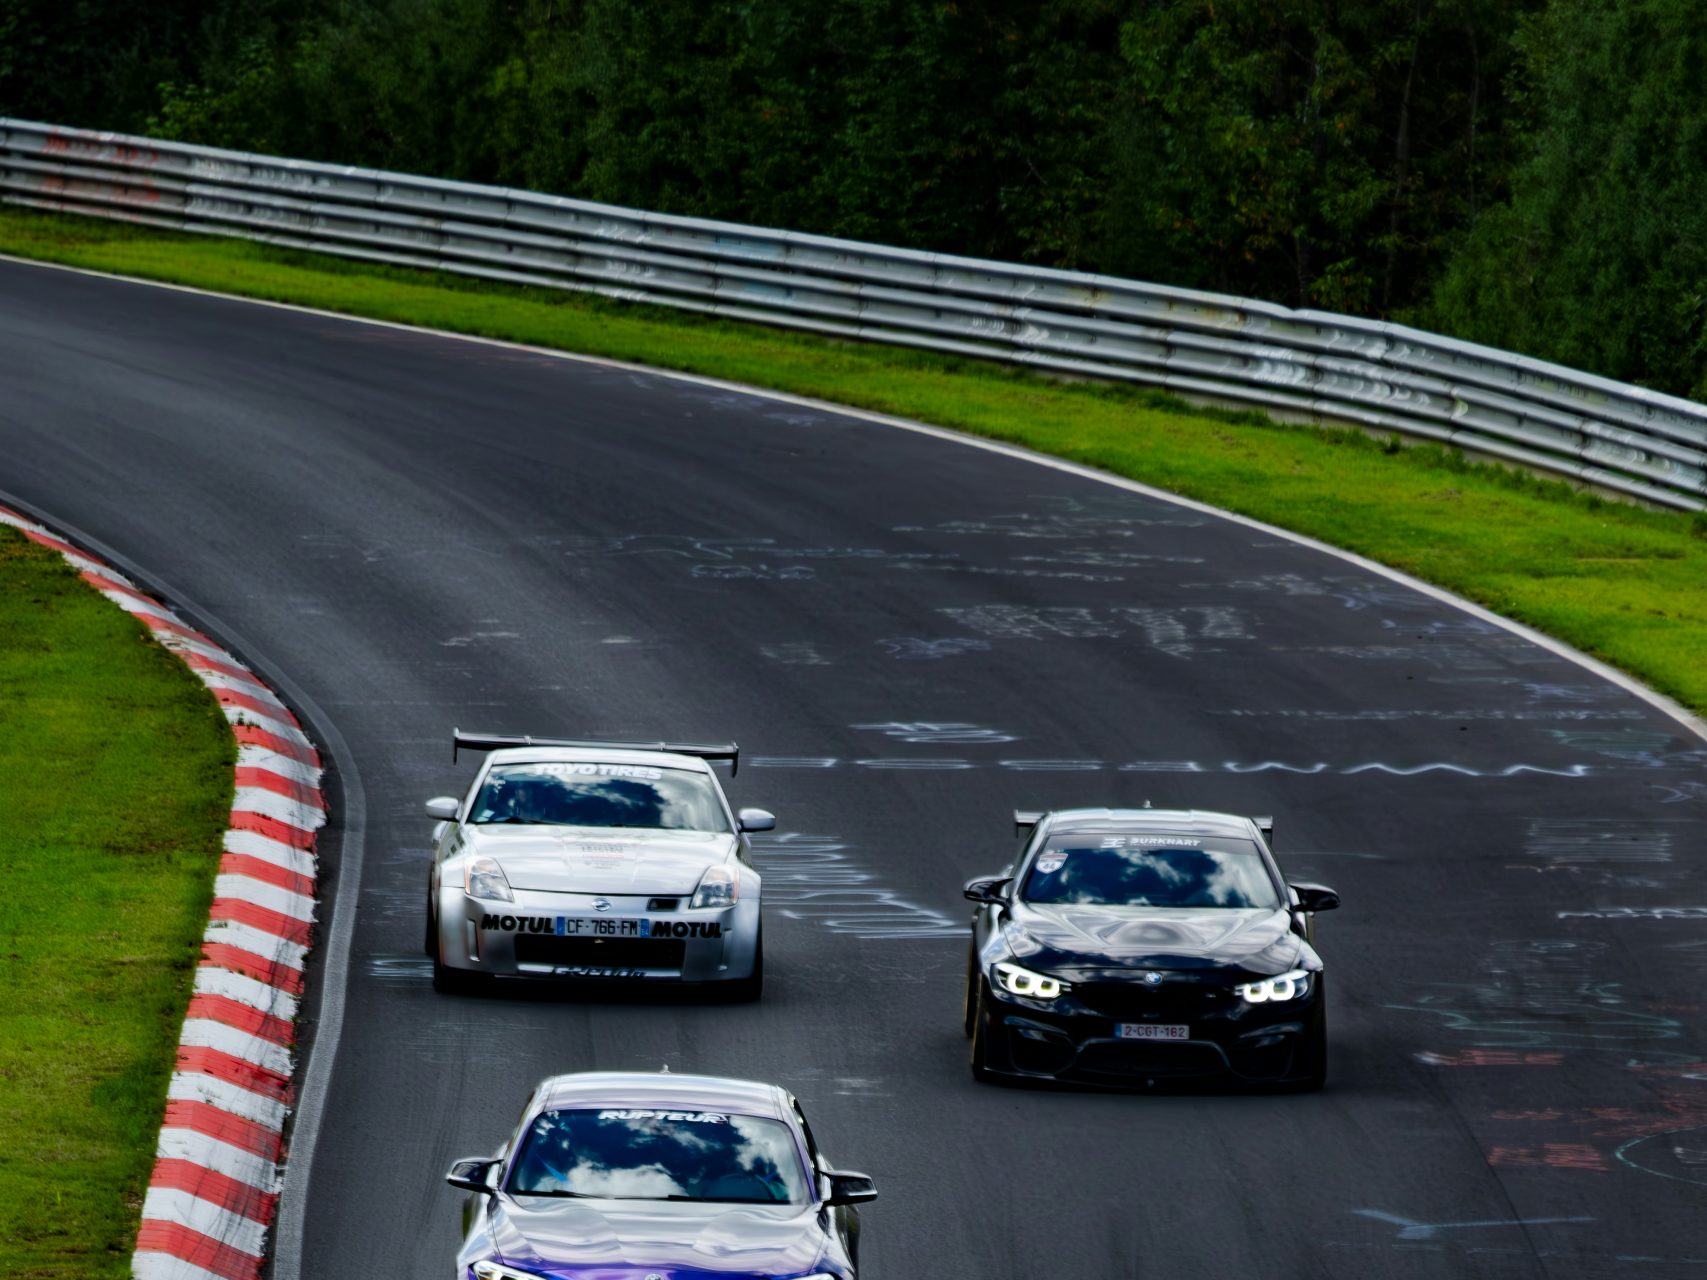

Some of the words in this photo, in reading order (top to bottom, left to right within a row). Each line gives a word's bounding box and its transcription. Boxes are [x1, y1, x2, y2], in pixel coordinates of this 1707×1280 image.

[481, 914, 555, 933] MOTUL
[567, 919, 638, 935] CF-766-FM
[652, 921, 722, 938] MOTUL
[598, 1109, 718, 1124] RUPTEUR
